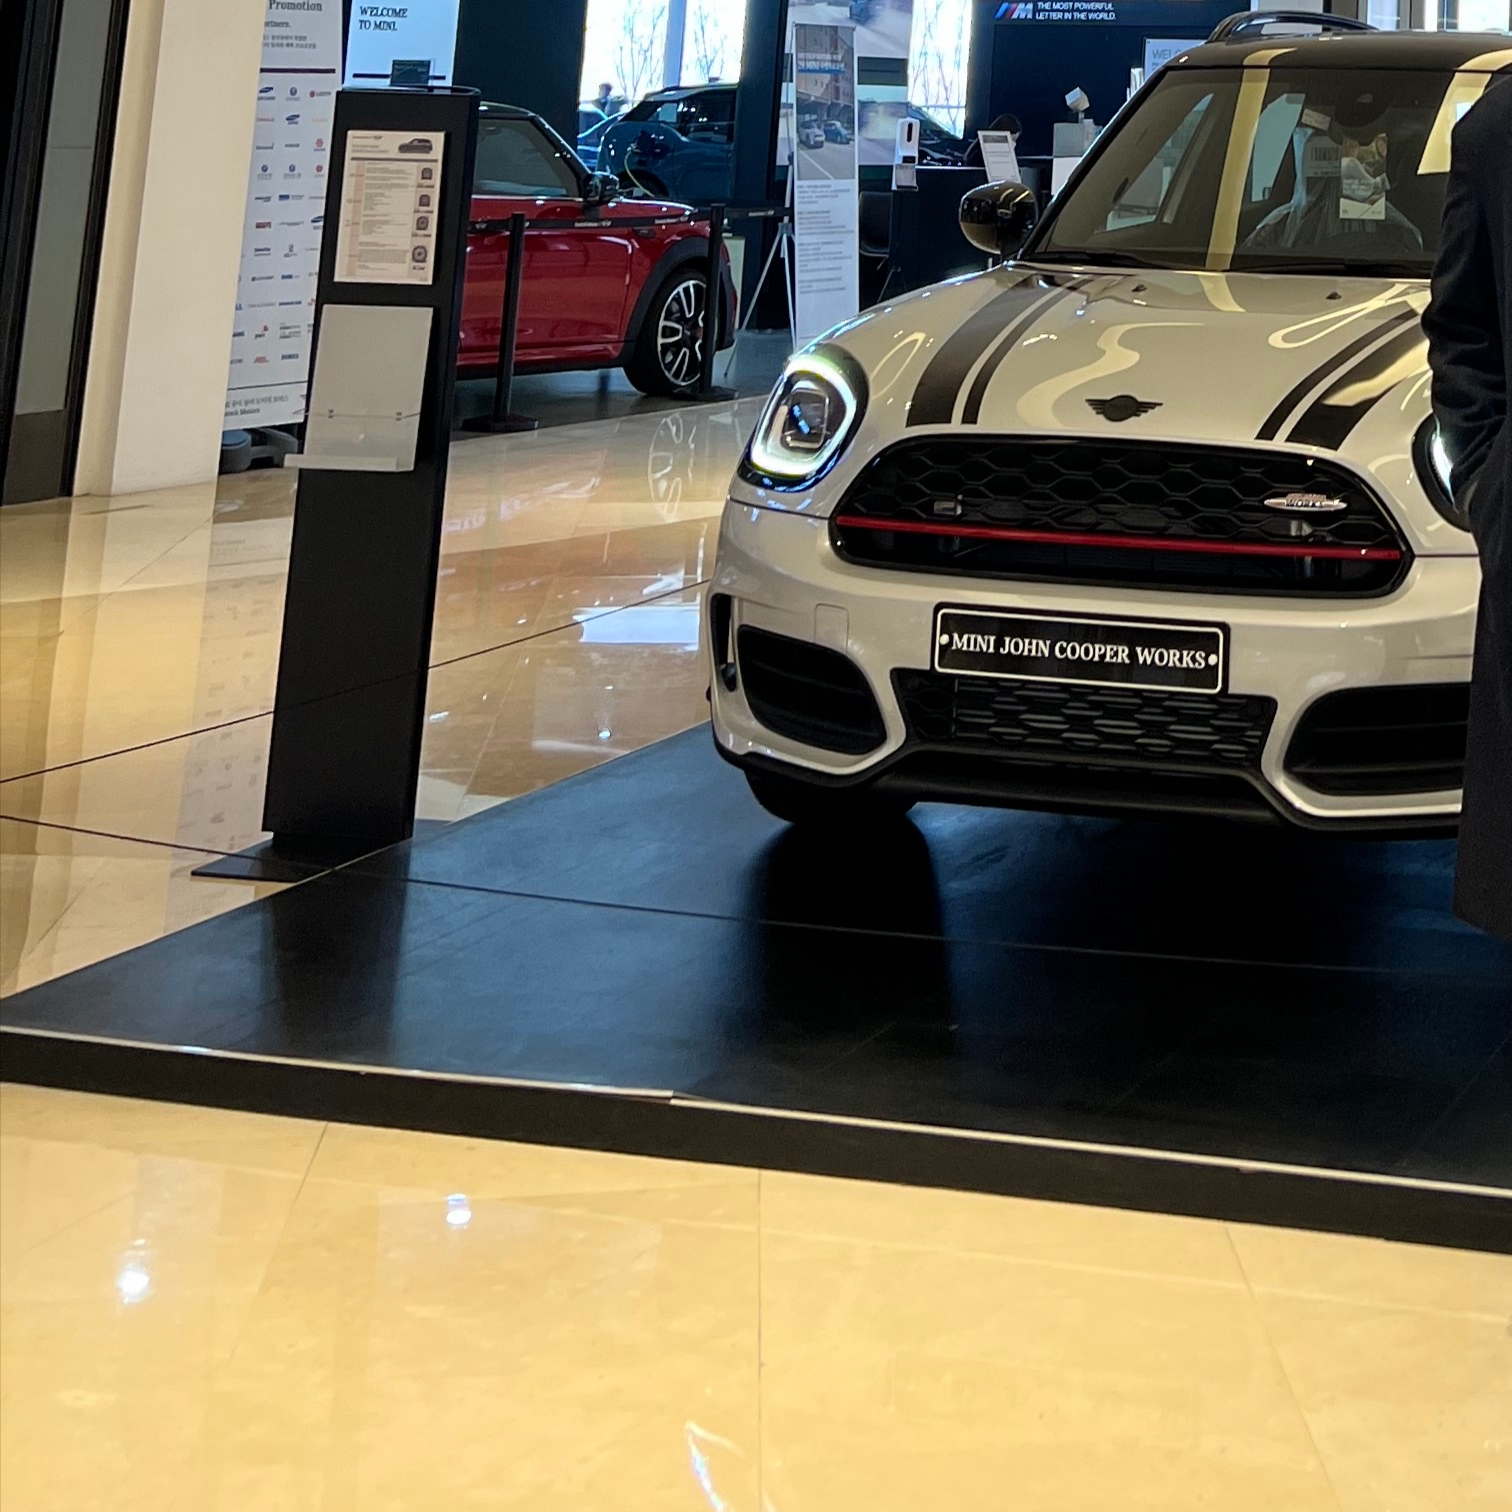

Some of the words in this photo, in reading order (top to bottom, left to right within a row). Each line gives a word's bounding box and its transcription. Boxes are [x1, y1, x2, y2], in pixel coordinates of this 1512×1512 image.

[1037, 2, 1052, 10] THE
[1053, 2, 1073, 10] MOST
[1074, 2, 1114, 10] POWERFUL
[360, 6, 408, 18] WELCOME
[1036, 12, 1063, 20] LETTER
[1064, 12, 1072, 20] IN
[1073, 12, 1087, 20] THE
[359, 19, 371, 30] TO
[951, 632, 996, 654] MINI
[1000, 637, 1051, 658] JOHN
[1054, 641, 1130, 664] COOPER
[1135, 646, 1206, 669] WORKS
